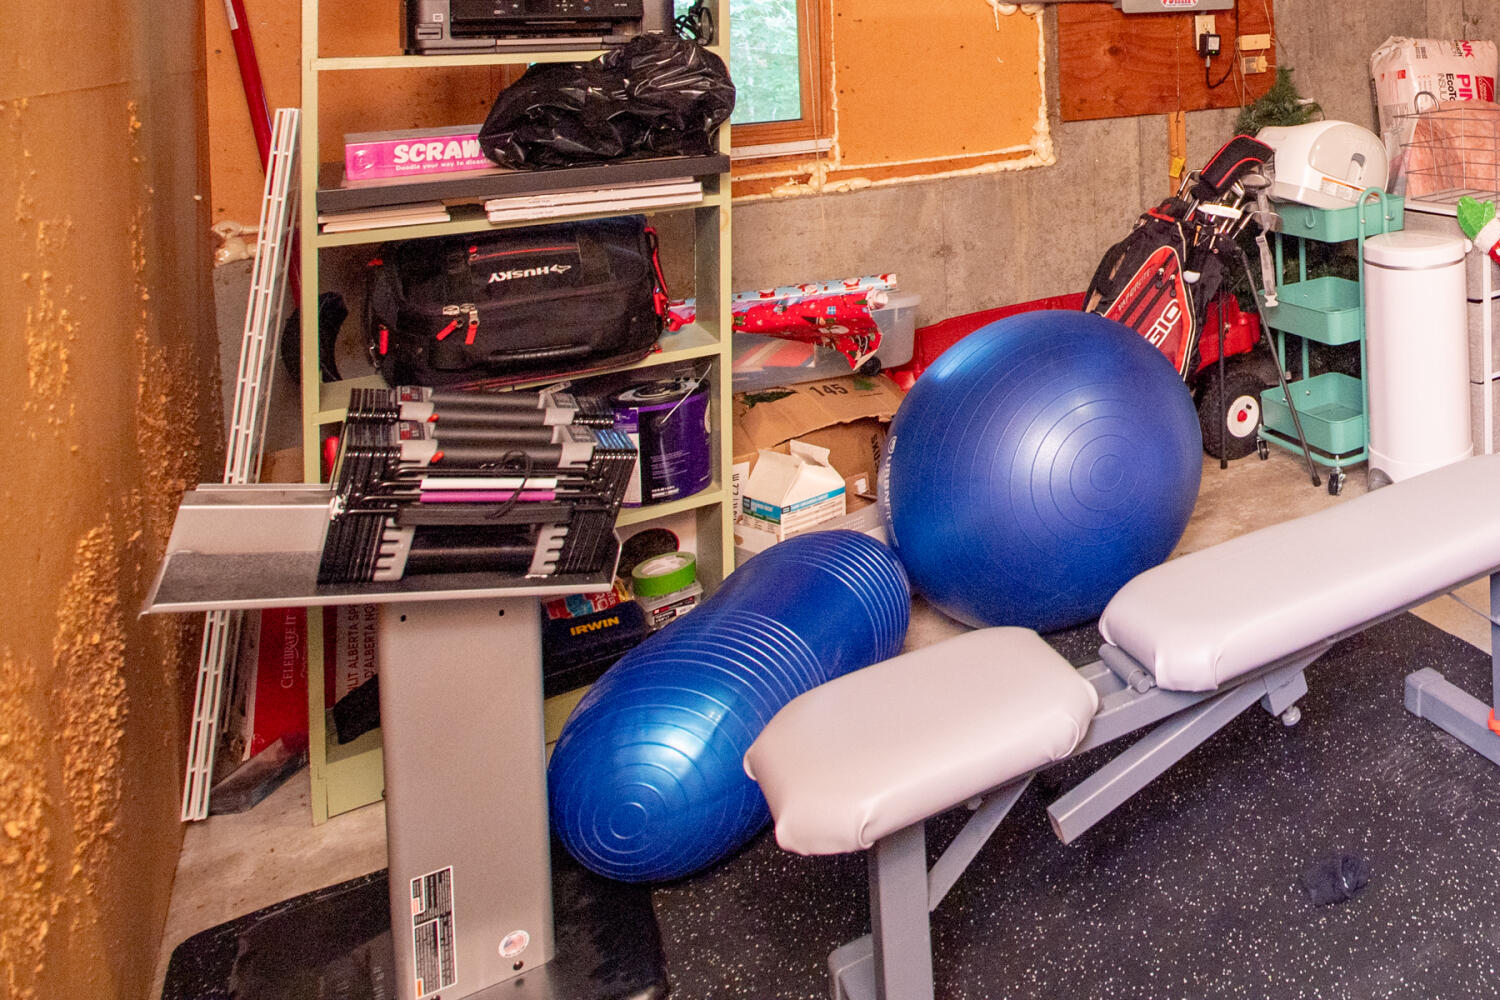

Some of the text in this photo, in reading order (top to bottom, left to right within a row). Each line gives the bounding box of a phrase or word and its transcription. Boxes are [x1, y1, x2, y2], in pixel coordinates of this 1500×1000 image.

[1445, 73, 1456, 101] EcoTo
[1456, 74, 1473, 102] PIN
[393, 139, 485, 164] SCRAW
[488, 266, 549, 284] HUSKY
[1144, 298, 1182, 349] GIO
[809, 383, 849, 397] 145
[569, 616, 620, 636] IRWIN
[347, 623, 359, 669] ALBERTA
